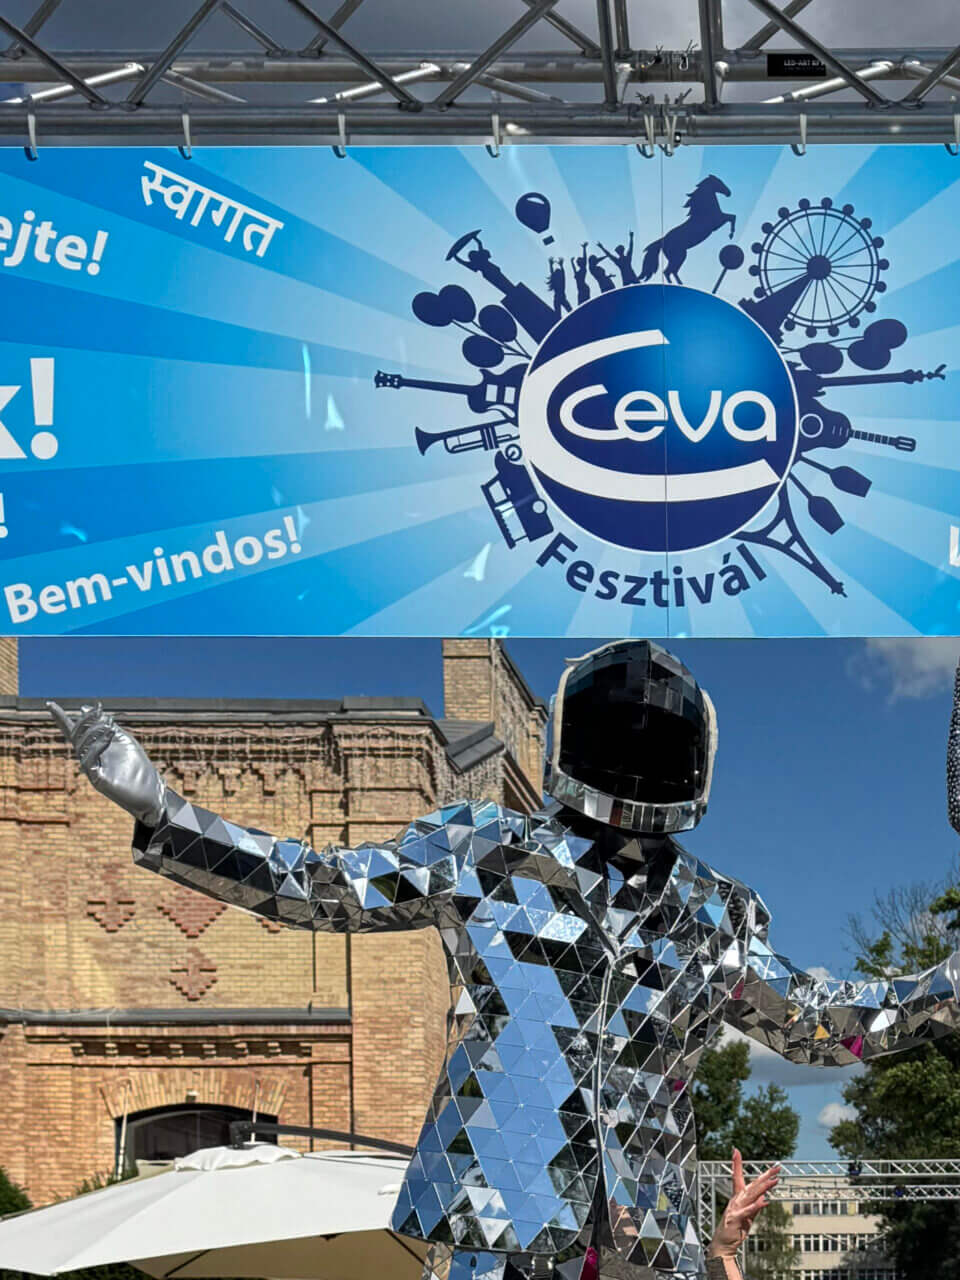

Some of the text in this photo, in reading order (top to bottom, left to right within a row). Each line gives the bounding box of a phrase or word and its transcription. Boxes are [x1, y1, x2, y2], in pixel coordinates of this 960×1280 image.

[141, 161, 284, 257] स्वागत
[4, 515, 303, 624] Bem-vindos!
[535, 532, 767, 608] Fesztivál
